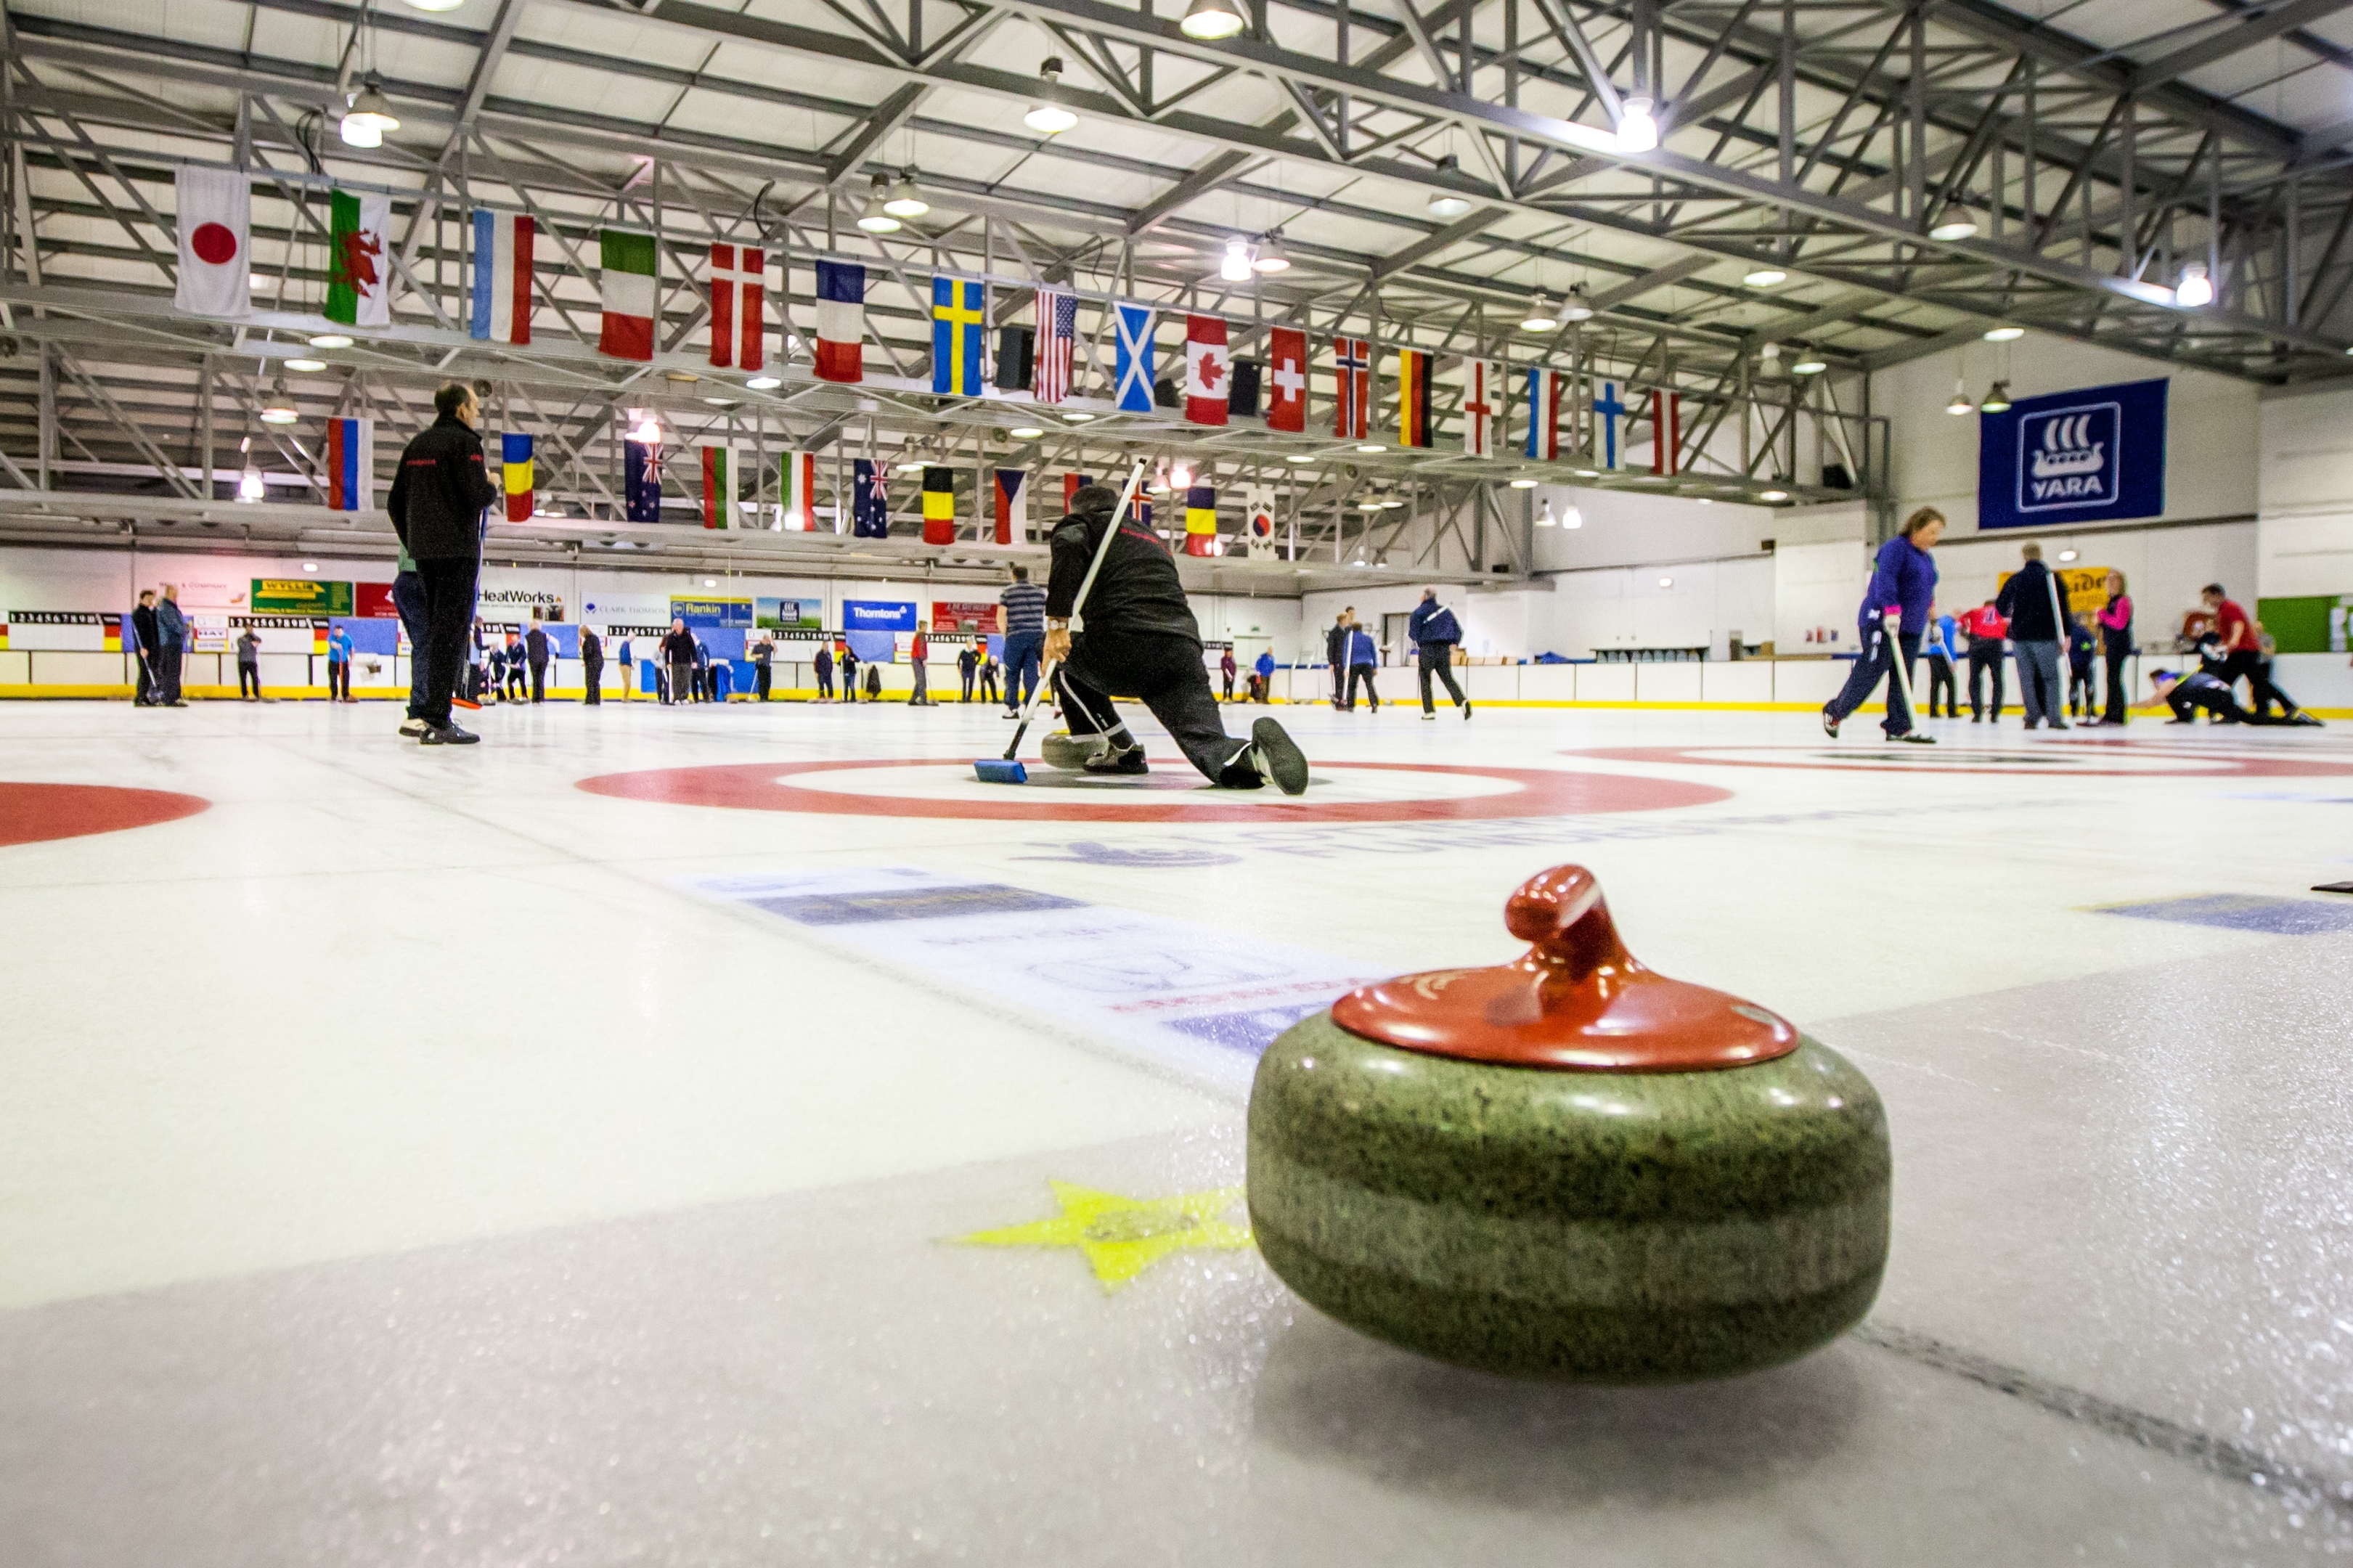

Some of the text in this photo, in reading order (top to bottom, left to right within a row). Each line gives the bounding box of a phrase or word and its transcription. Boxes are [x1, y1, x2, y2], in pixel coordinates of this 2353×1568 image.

[2031, 475, 2103, 500] YARA
[685, 603, 721, 614] Rankin
[853, 607, 902, 619] Thorntons
